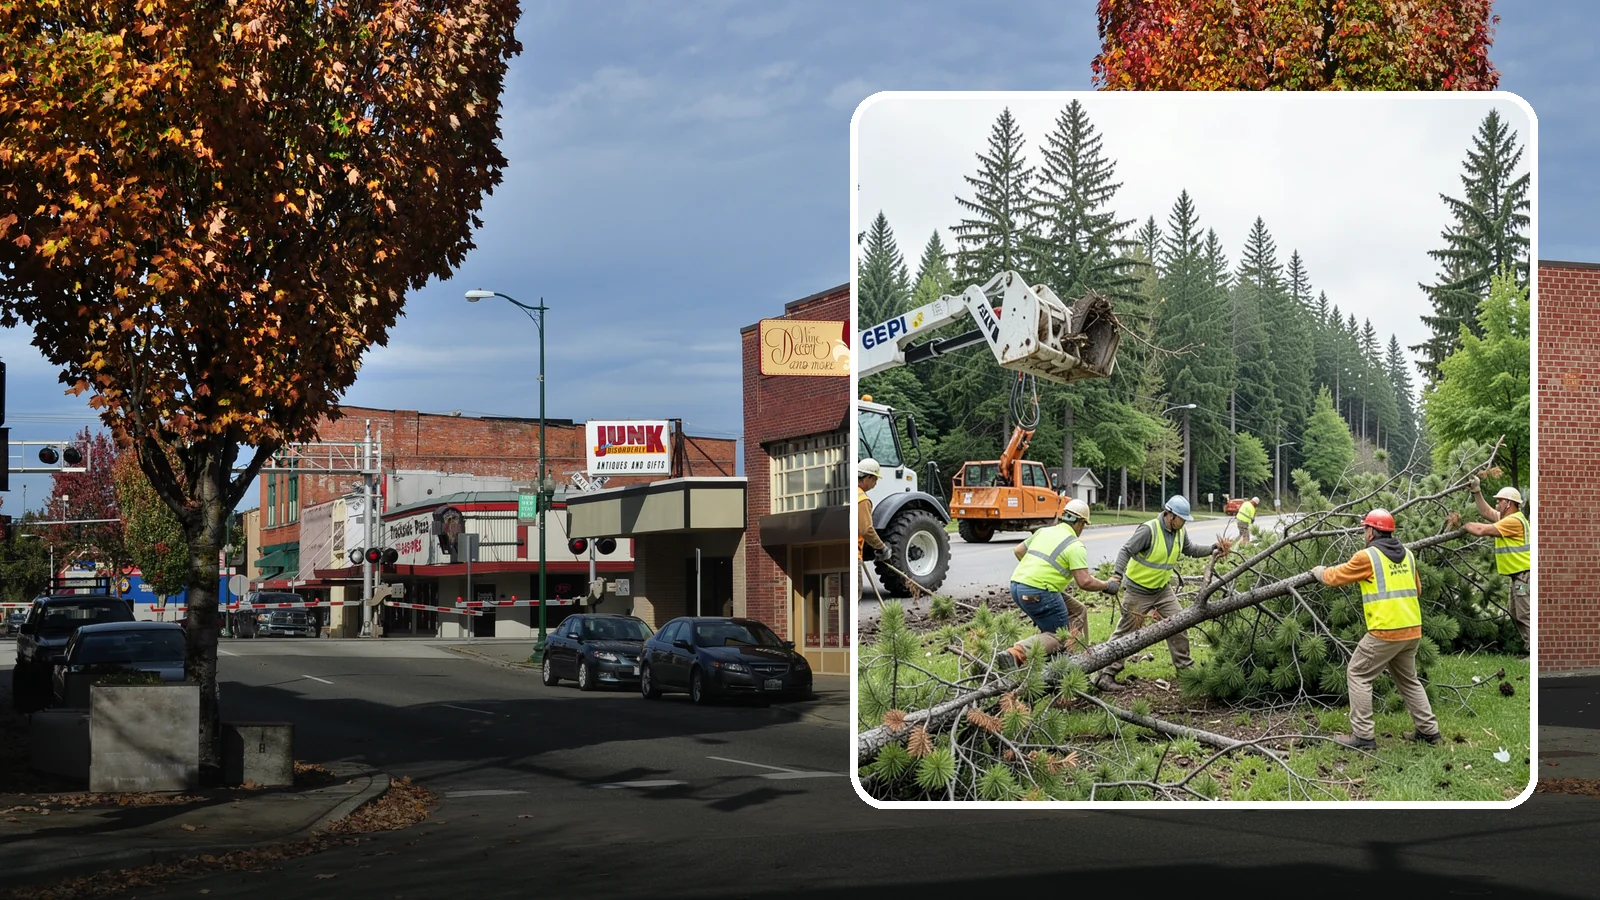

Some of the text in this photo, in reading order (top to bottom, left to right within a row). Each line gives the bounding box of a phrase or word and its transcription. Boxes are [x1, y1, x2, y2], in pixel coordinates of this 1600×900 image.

[862, 316, 908, 350] GEPI
[595, 425, 665, 457] JUNK
[607, 446, 646, 454] DISORDERLY
[597, 460, 665, 470] ANTIQUES AND GIFTS
[352, 498, 365, 511] CRO
[414, 519, 429, 535] Pizza
